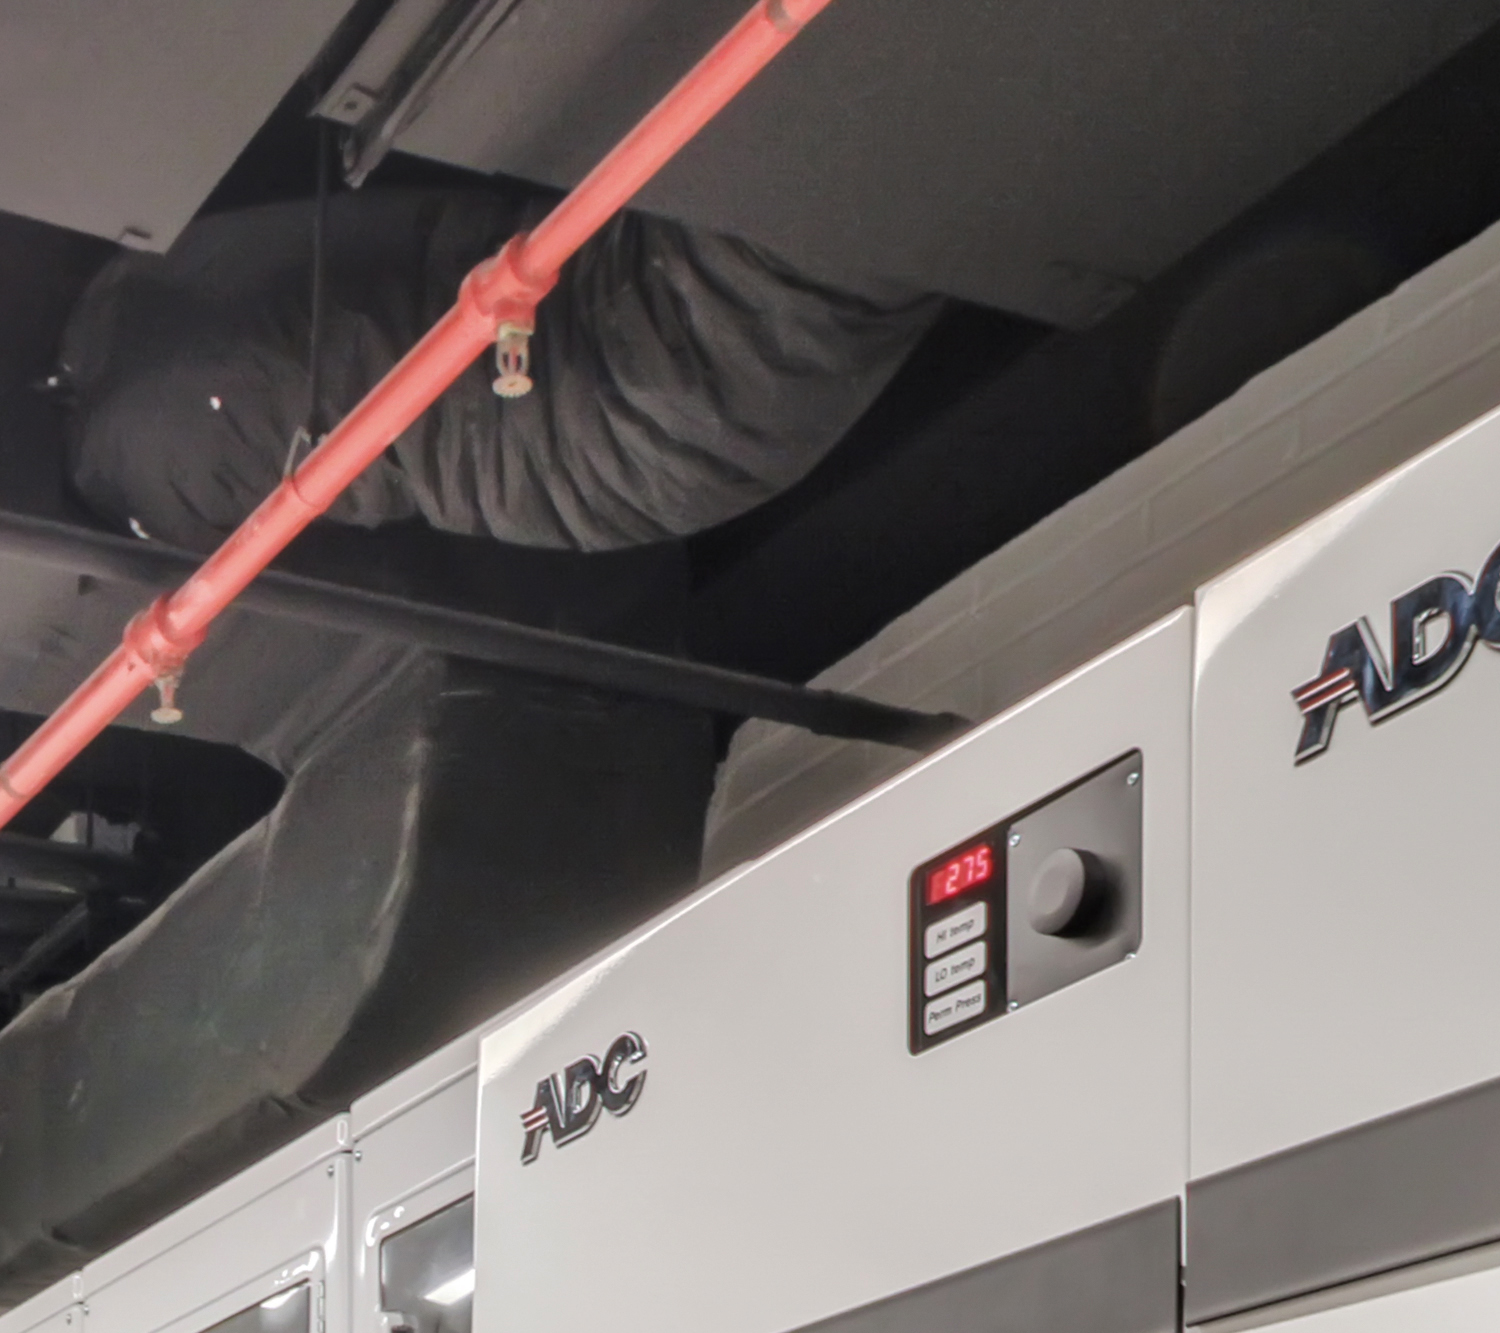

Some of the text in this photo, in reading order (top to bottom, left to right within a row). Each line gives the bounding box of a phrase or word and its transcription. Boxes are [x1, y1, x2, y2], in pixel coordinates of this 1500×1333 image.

[945, 848, 989, 895] 275
[950, 918, 975, 938] temp
[935, 956, 976, 983] LO temp
[928, 993, 982, 1024] Perm Press
[520, 1031, 648, 1167] ADC
